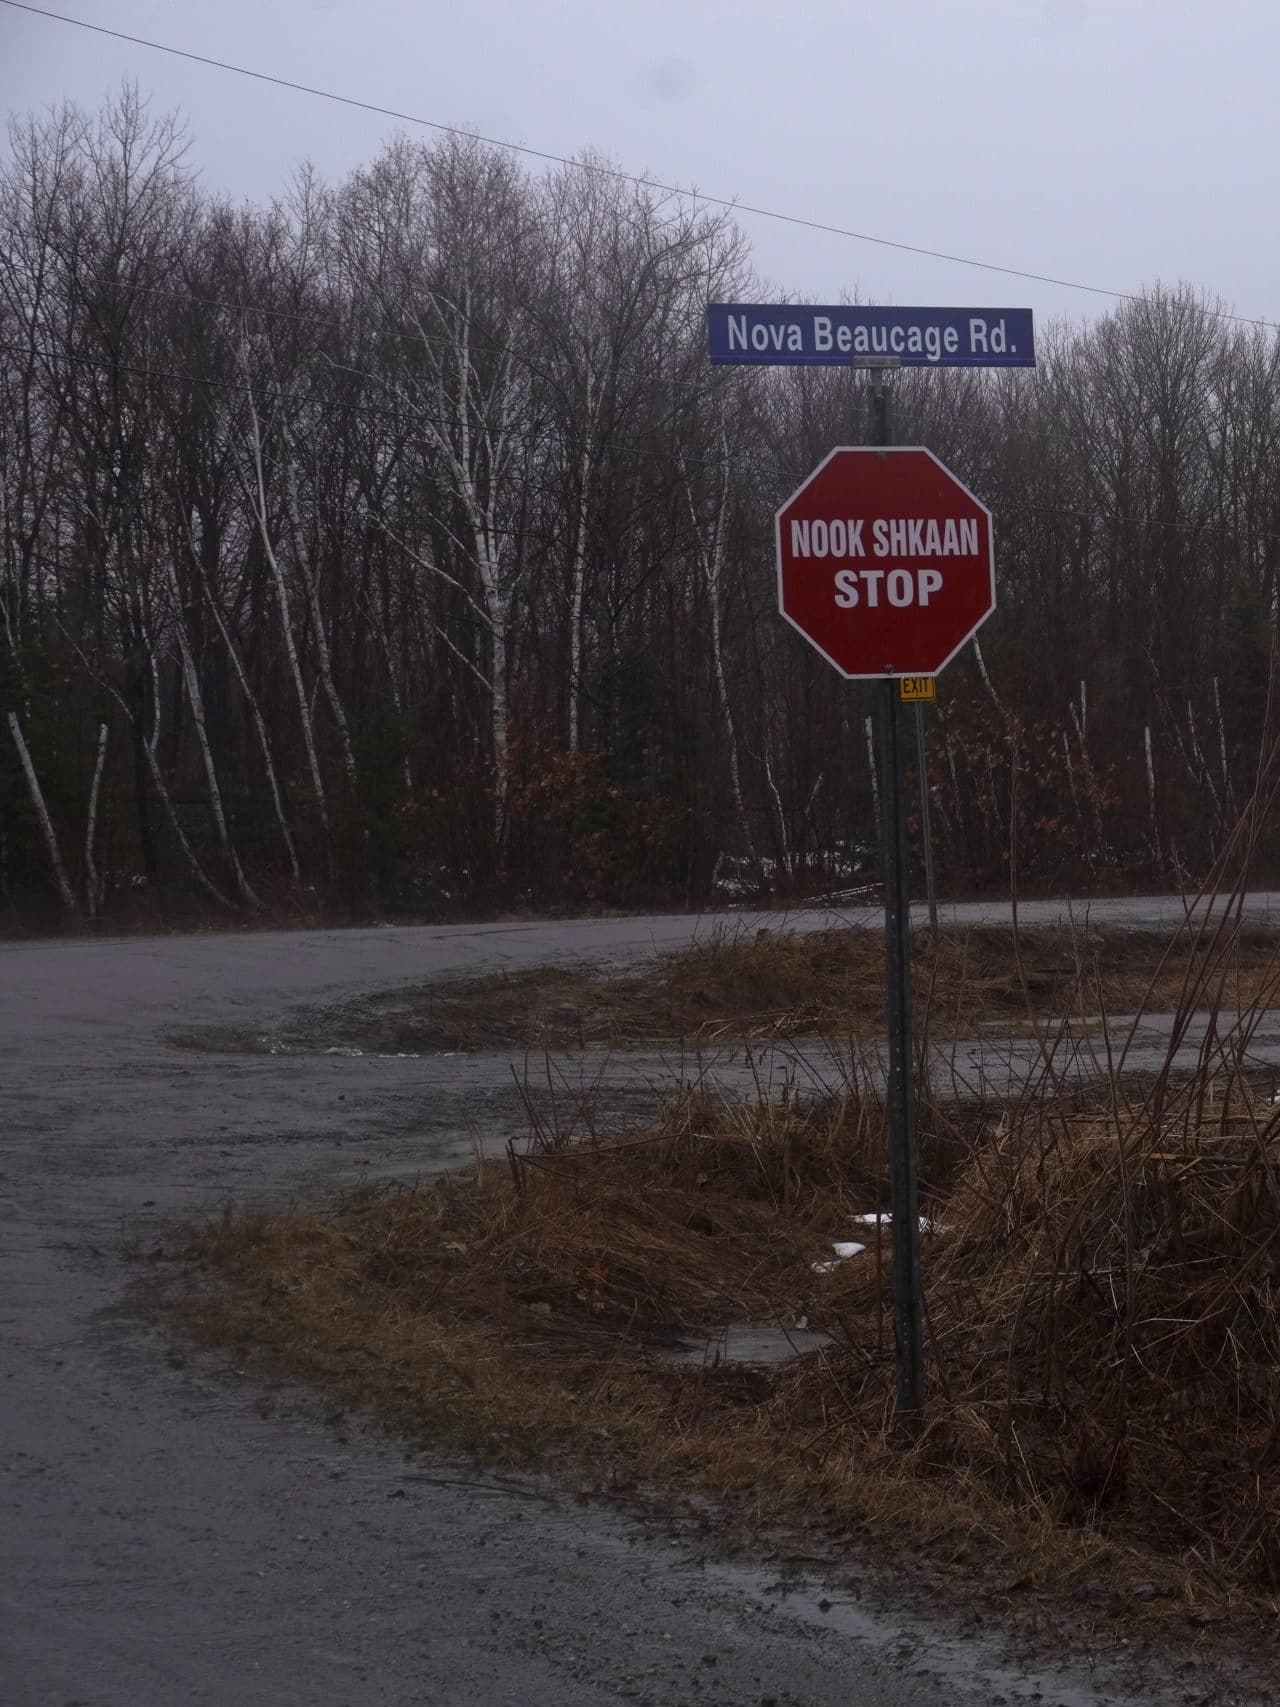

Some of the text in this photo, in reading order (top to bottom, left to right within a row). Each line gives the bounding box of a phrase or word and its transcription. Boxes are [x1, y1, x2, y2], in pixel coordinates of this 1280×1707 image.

[727, 314, 1017, 362] Nova Beaucage Rd.
[790, 518, 979, 559] NOOK SHKAAN
[834, 568, 944, 609] STOP
[903, 677, 929, 693] EXIT
